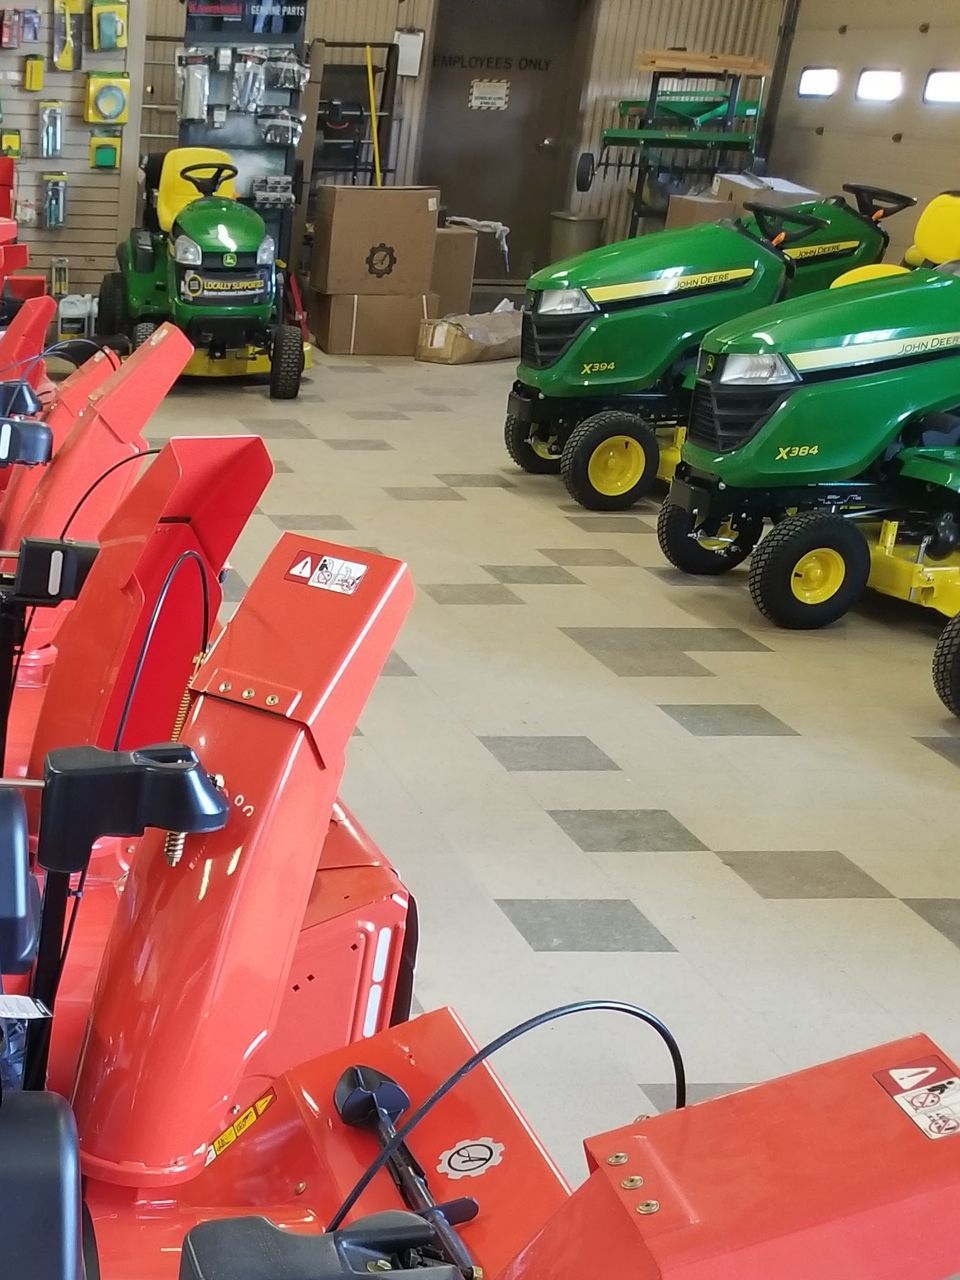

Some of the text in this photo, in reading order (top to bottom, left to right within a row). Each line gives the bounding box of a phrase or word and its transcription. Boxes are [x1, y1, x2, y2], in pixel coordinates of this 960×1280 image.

[282, 6, 305, 17] PARTS
[433, 55, 552, 72] EMPLOYEES ONLY
[674, 271, 730, 290] JOHN DEERE
[895, 340, 929, 356] JOHN
[580, 361, 616, 375] X394
[775, 444, 819, 461] X384
